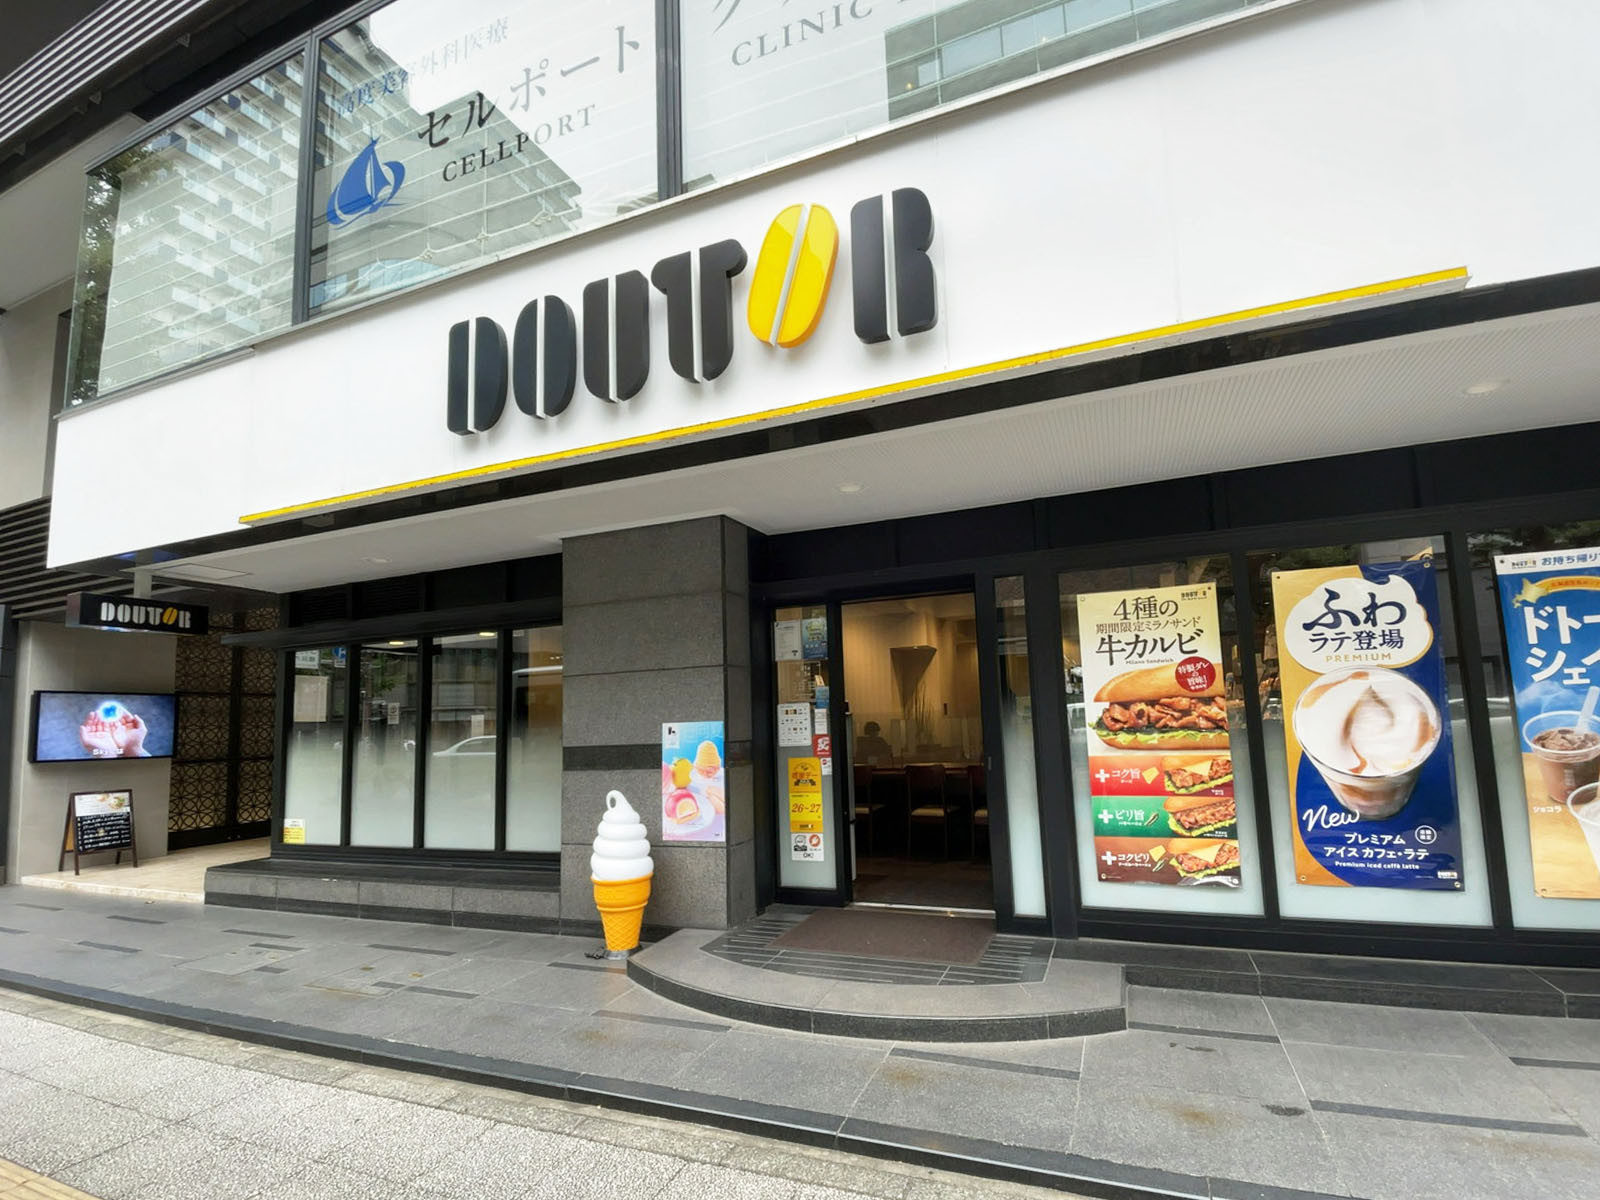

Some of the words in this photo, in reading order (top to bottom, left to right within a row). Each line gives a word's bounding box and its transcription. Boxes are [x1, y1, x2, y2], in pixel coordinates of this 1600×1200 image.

[731, 0, 873, 67] CLINIC
[417, 25, 641, 148] セルポート
[442, 104, 597, 182] CELLPORT
[446, 186, 939, 437] DOUTOR
[1541, 552, 1600, 566] お持ち帰り
[100, 602, 192, 629] DOUTOR
[1113, 595, 1179, 621] 4種の
[1302, 587, 1407, 631] ふわ
[1096, 616, 1201, 635] 期間限定ミラノサンド
[1095, 628, 1204, 666] 牛カルビ
[1309, 628, 1404, 653] ラテ登場
[1325, 652, 1392, 663] PREMIUM
[1302, 805, 1360, 832] New
[1324, 846, 1359, 858] アイス
[1344, 832, 1406, 845] プレミアム
